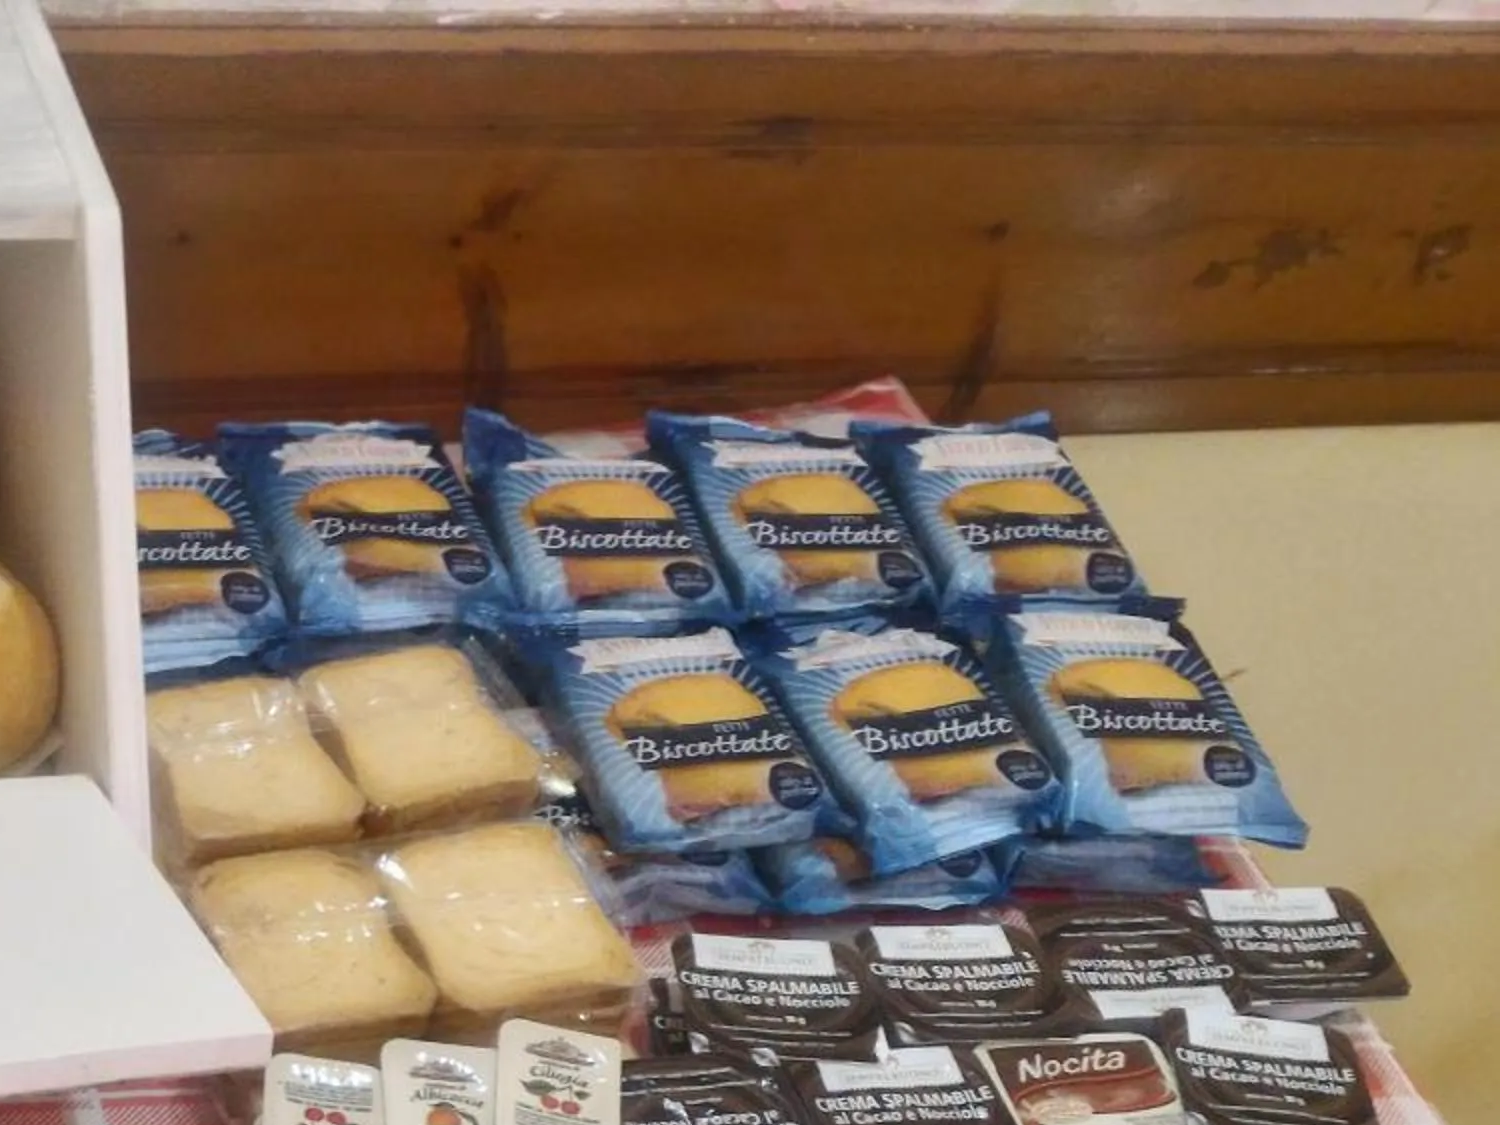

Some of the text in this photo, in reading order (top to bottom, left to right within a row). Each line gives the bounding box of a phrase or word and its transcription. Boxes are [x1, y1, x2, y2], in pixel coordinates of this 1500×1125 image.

[311, 517, 469, 539] Biscottate
[534, 525, 692, 549] Biscottate
[745, 520, 899, 545] Biscottate
[955, 523, 1109, 545] Biscottate
[1066, 703, 1225, 733] Biscottate
[851, 711, 1012, 753] Biscottate
[623, 729, 791, 763] Biscottate
[869, 960, 1041, 979] CREMA SPALMABILE
[680, 971, 861, 995] CREMA SPALMABILE
[712, 989, 762, 1005] Cacao
[1018, 1047, 1126, 1083] Nocita
[1176, 1046, 1357, 1082] CREMA SPALMABILE
[815, 1085, 995, 1113] CREMA SPALMABILE
[851, 1110, 904, 1124] Cacao
